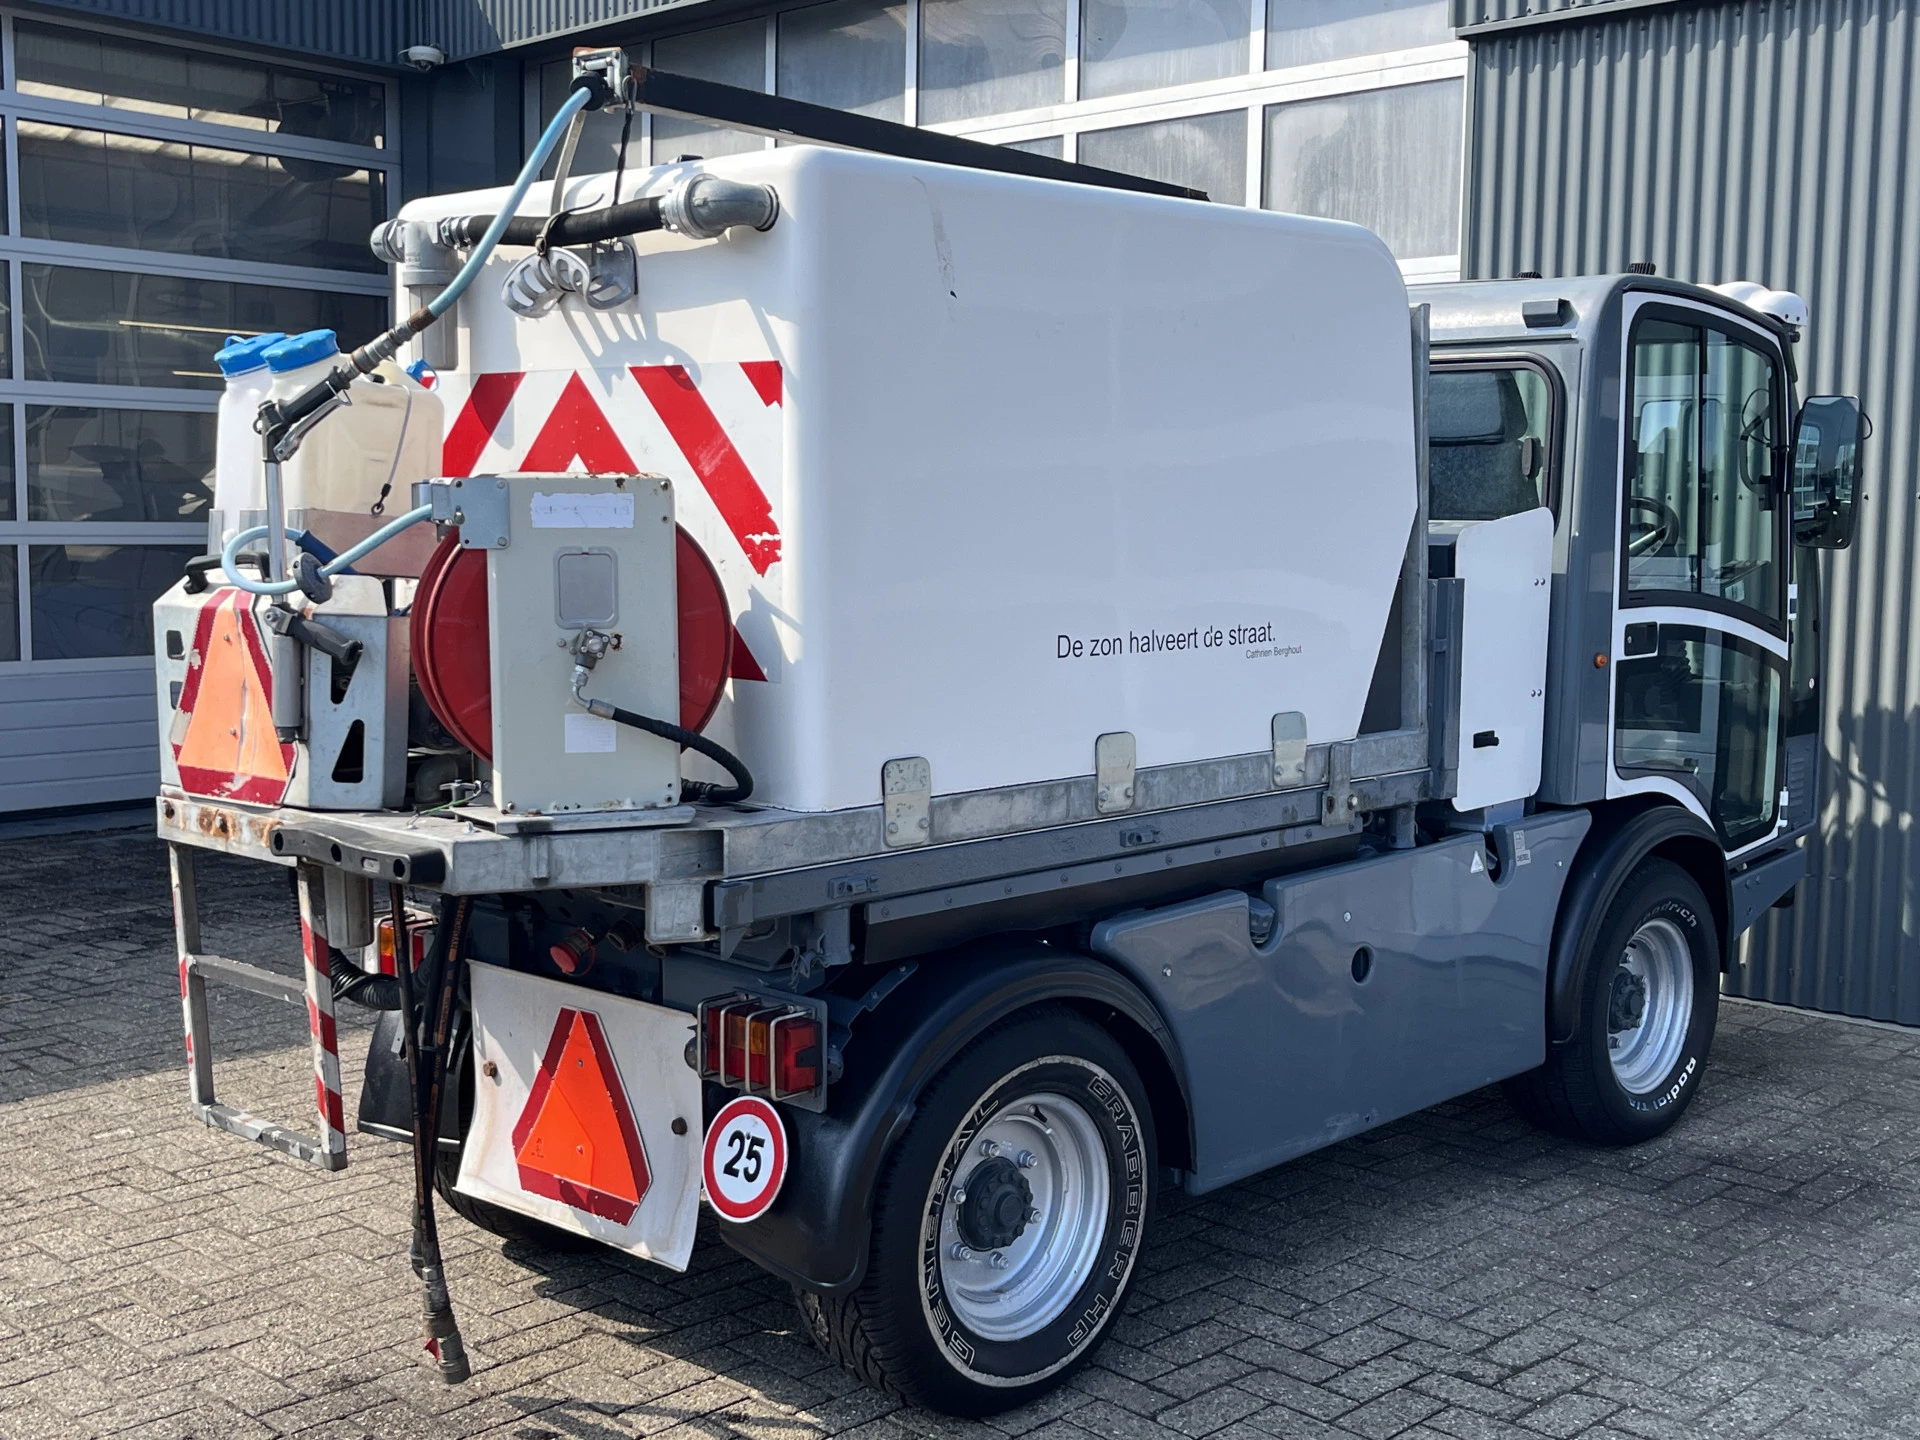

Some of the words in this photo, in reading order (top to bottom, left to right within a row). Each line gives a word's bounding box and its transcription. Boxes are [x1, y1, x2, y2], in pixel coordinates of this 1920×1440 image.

[1057, 634, 1083, 658] De
[1089, 637, 1122, 656] zon
[1129, 627, 1198, 654] halveert
[1203, 625, 1223, 648] de
[1228, 621, 1276, 646] straat.
[1652, 1057, 1697, 1110] Radial
[722, 1129, 766, 1183] 25
[1087, 1076, 1143, 1280] GRABBER
[925, 1100, 999, 1368] GENERAL
[1066, 1293, 1109, 1347] HP
